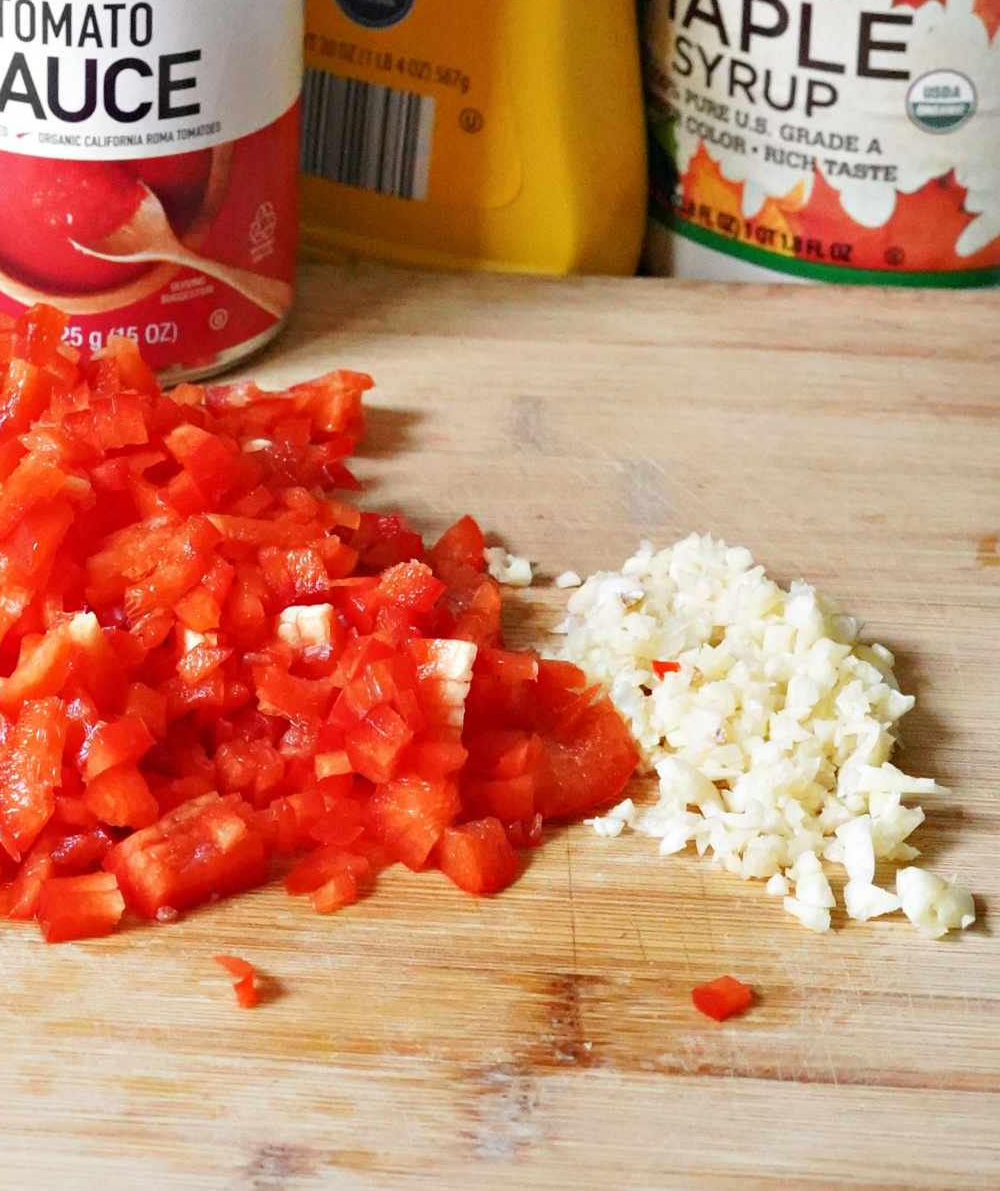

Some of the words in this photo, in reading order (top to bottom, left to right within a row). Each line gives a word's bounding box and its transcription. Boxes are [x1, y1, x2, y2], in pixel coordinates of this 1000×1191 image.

[671, 34, 839, 118] SYRUP
[38, 131, 82, 148] ORGANIC
[84, 134, 143, 148] CALIFORNIA
[145, 130, 174, 145] ROMA
[176, 120, 222, 141] TOMATOES
[685, 115, 748, 155] COLOR
[763, 143, 817, 174] RICH
[822, 157, 899, 183] TASTE
[779, 122, 860, 154] GRADE
[866, 136, 883, 156] A
[88, 331, 102, 351] g
[144, 321, 178, 345] OZ)
